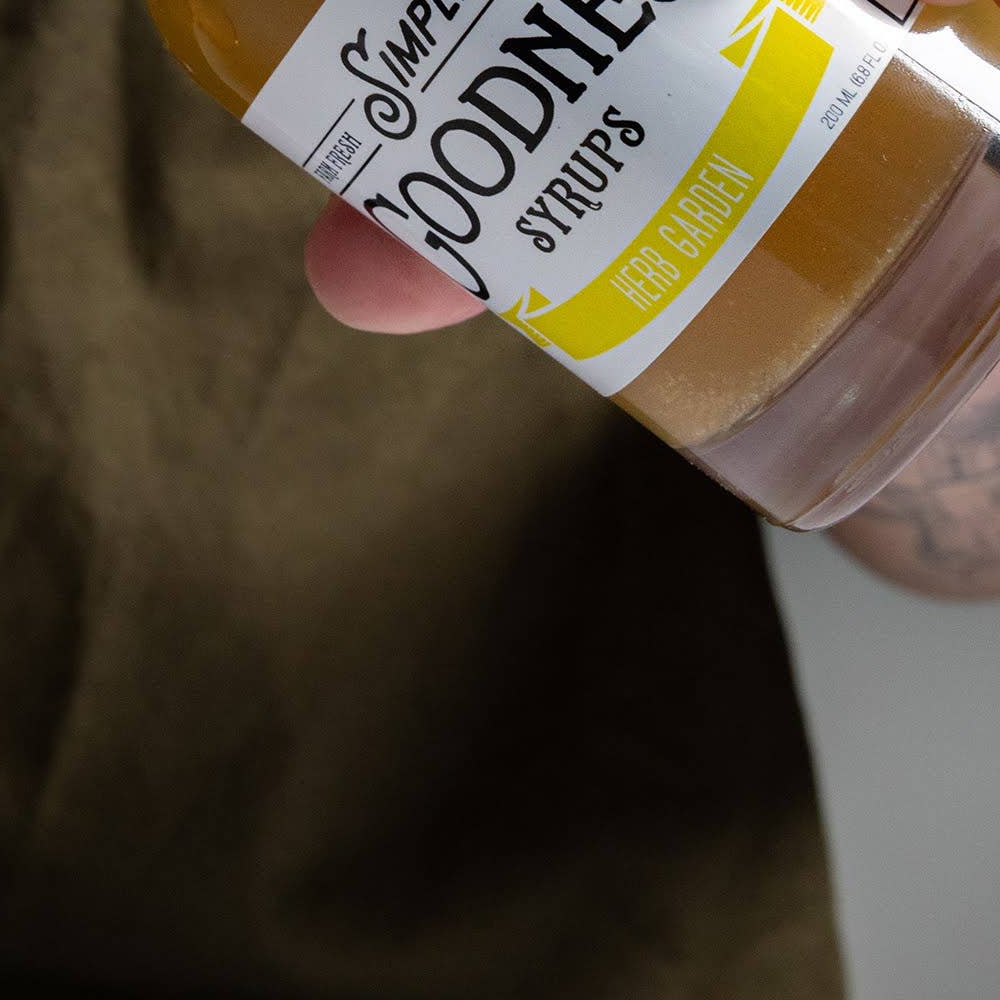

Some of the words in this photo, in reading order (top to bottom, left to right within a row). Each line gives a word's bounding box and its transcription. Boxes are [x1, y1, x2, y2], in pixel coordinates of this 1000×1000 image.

[820, 102, 845, 130] 200
[839, 86, 858, 111] ML
[850, 64, 872, 89] (6.8
[864, 50, 882, 71] FL
[325, 131, 362, 171] FRESH
[515, 104, 646, 254] SYRUPS
[608, 245, 682, 312] HERB
[657, 152, 755, 259] GARDEN
